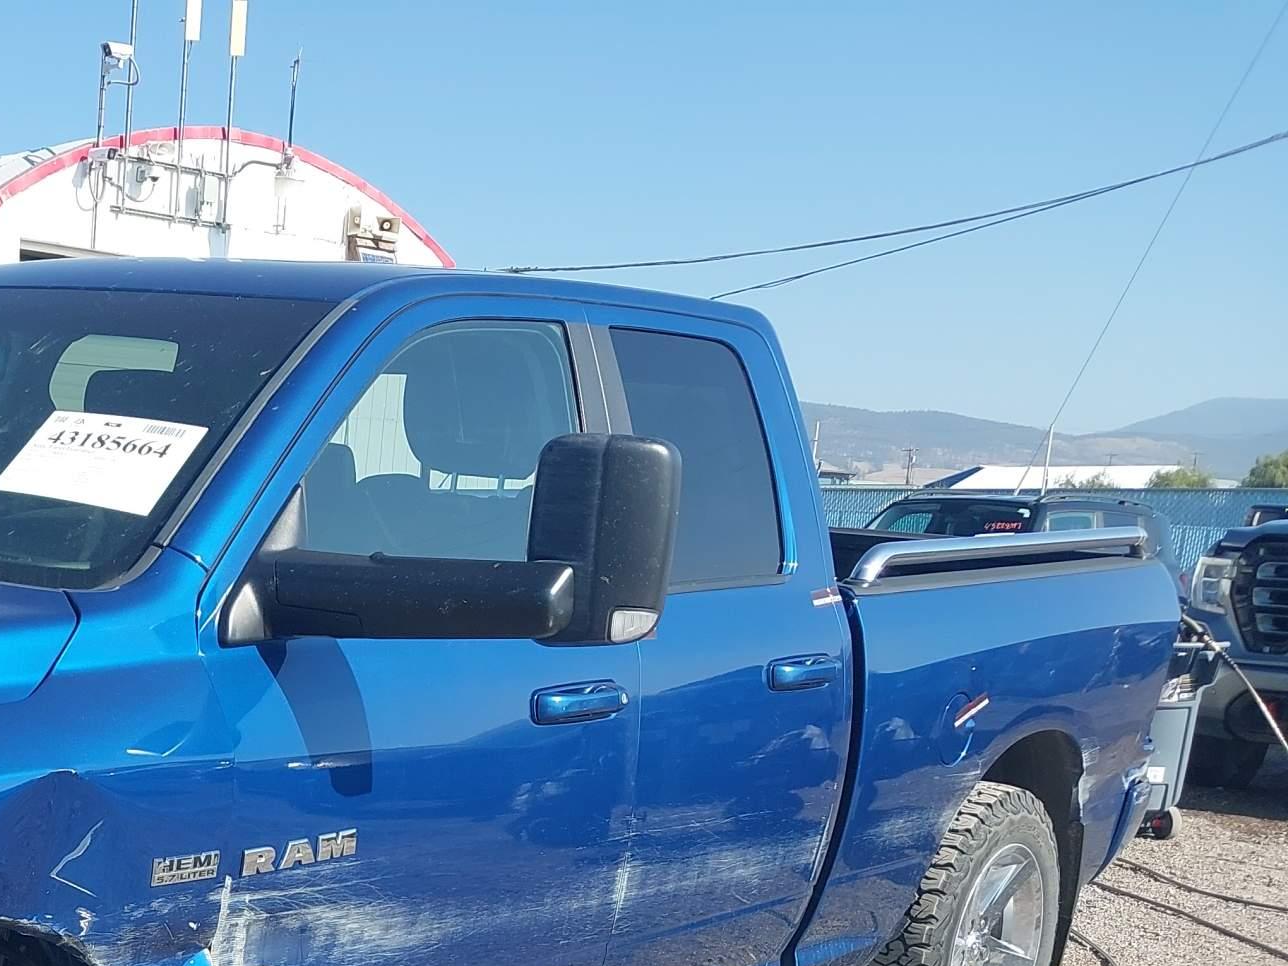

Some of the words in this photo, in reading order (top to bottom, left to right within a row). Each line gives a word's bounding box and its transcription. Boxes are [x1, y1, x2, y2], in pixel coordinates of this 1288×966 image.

[47, 429, 172, 459] 43185664
[156, 852, 220, 874] HEMI
[241, 828, 358, 877] RAM
[156, 874, 177, 885] 5.7
[179, 868, 215, 881] LITER
